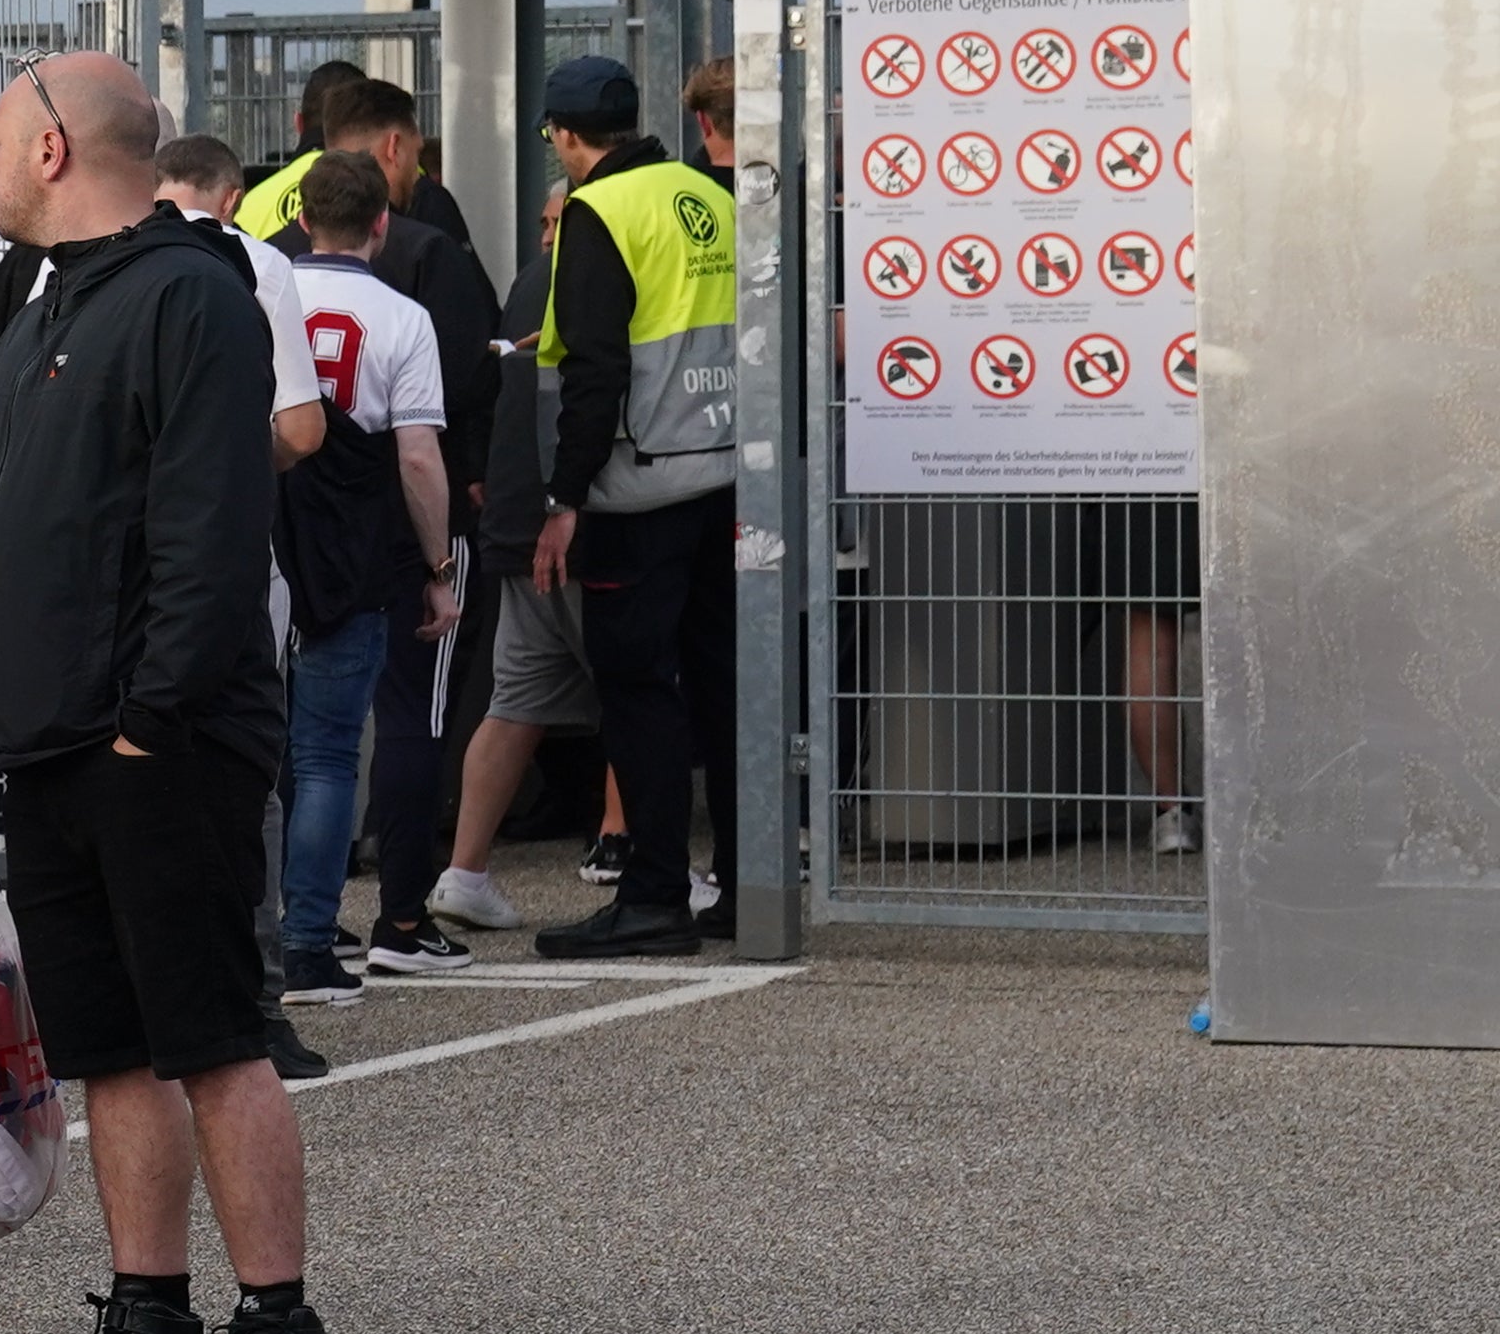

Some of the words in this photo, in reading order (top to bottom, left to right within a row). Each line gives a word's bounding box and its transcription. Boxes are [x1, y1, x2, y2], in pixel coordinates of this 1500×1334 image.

[304, 307, 367, 414] 9
[912, 452, 931, 462] Den
[932, 452, 993, 464] Anweisungen
[995, 451, 1011, 462] des
[1013, 451, 1099, 462] Sicherheitsdienstes
[1101, 451, 1112, 461] ist
[1114, 451, 1139, 463] Folge
[1142, 453, 1153, 461] zu
[921, 466, 939, 476] You
[940, 466, 964, 476] must
[965, 466, 1002, 476] observe
[1003, 465, 1056, 476] instructions
[1058, 465, 1083, 478] given
[1084, 465, 1097, 477] by
[1098, 465, 1135, 477] security
